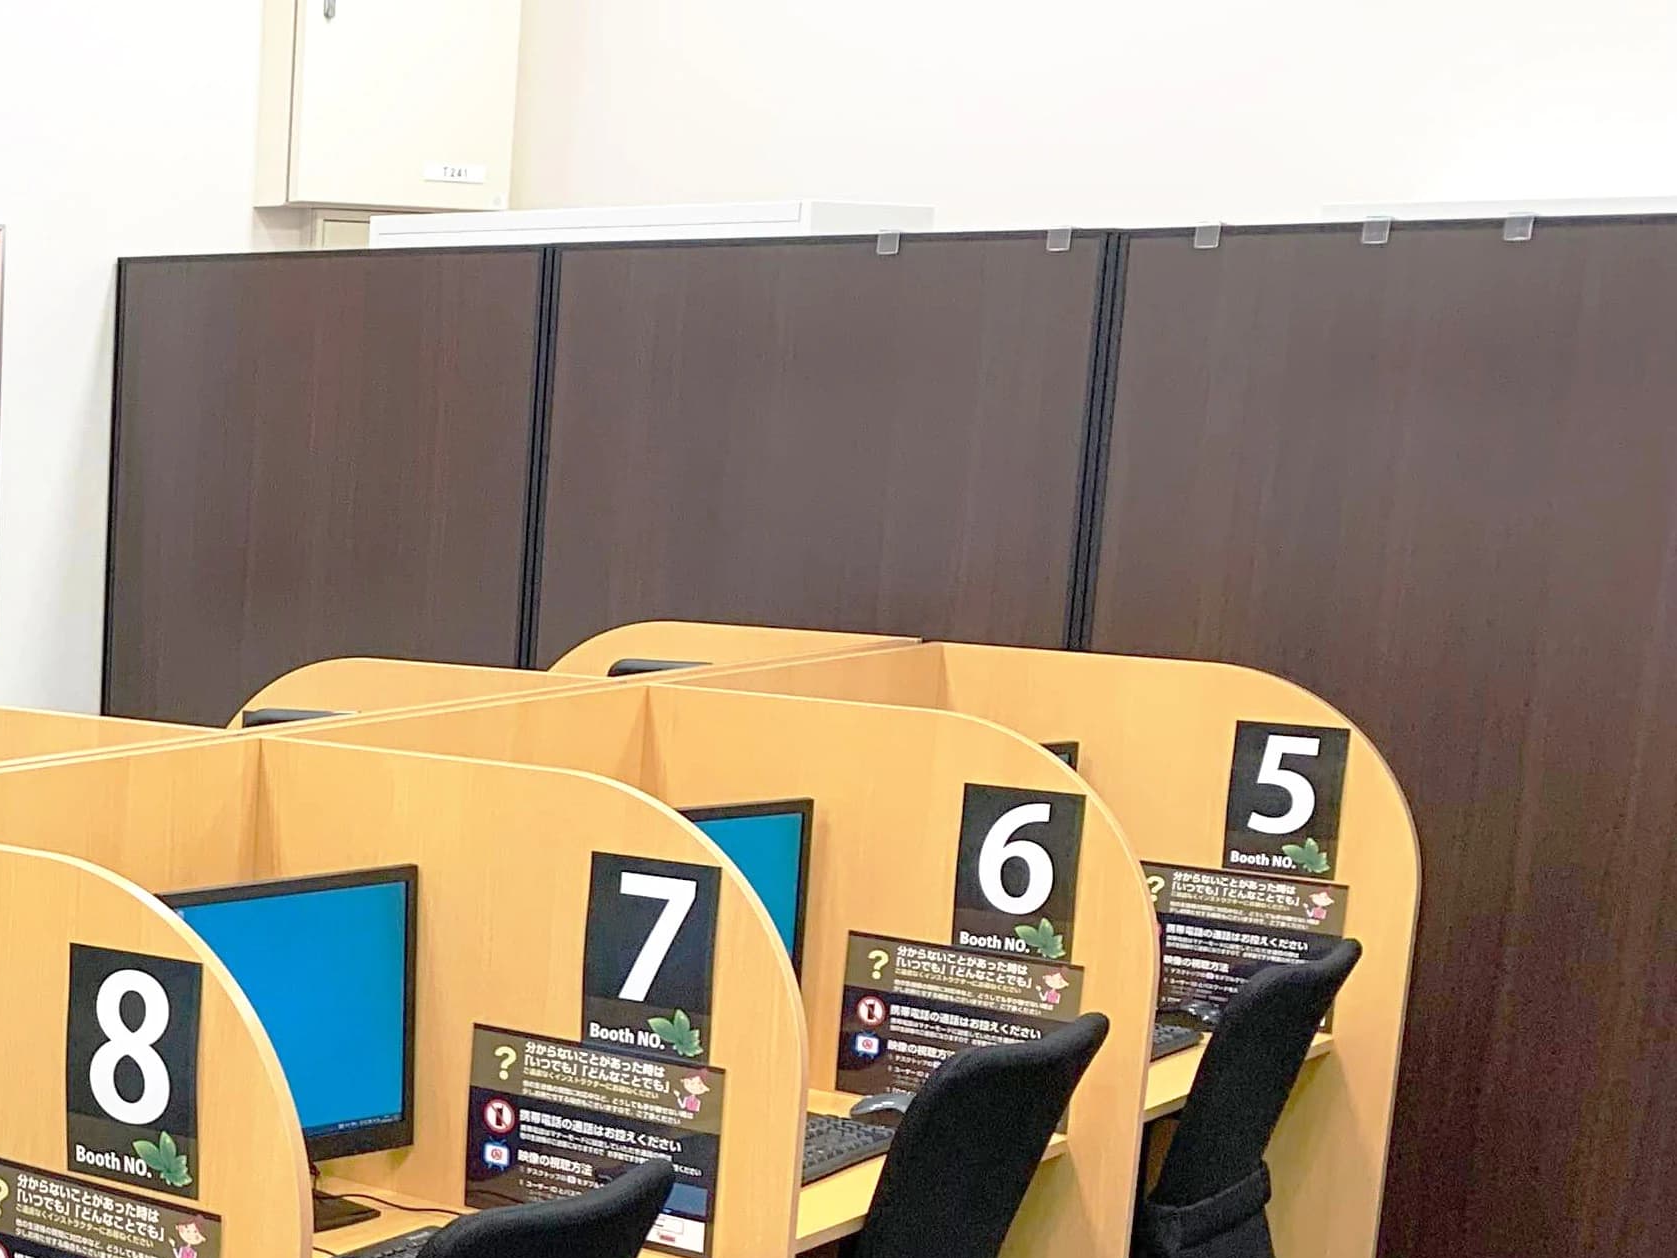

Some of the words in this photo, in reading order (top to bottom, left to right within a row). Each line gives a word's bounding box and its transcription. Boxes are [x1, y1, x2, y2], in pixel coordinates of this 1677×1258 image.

[1247, 734, 1320, 834] 5
[978, 803, 1054, 915] 6
[1230, 850, 1269, 867] Booth
[1272, 855, 1297, 870] NO.
[618, 871, 697, 1002] 7
[959, 930, 1002, 950] Booth
[1004, 938, 1030, 954] NO.
[897, 945, 1028, 975] 分からないことがあった時は
[589, 1022, 634, 1044] Booth
[637, 1031, 666, 1050] NO.
[889, 1004, 1042, 1040] 携帯電話の通話はお控えください
[89, 969, 171, 1125] 8
[524, 1042, 665, 1078] 分からないことがあった時は
[524, 1054, 670, 1093] 「いつでも」「どんなことでも」
[519, 1109, 682, 1153] 携帯電話の通話はお控えください
[75, 1144, 121, 1171] Booth
[123, 1155, 153, 1178] NO.
[17, 1173, 160, 1221] 分からないことがあった時は
[17, 1188, 165, 1242] 「いつでも」「どんなことでも」
